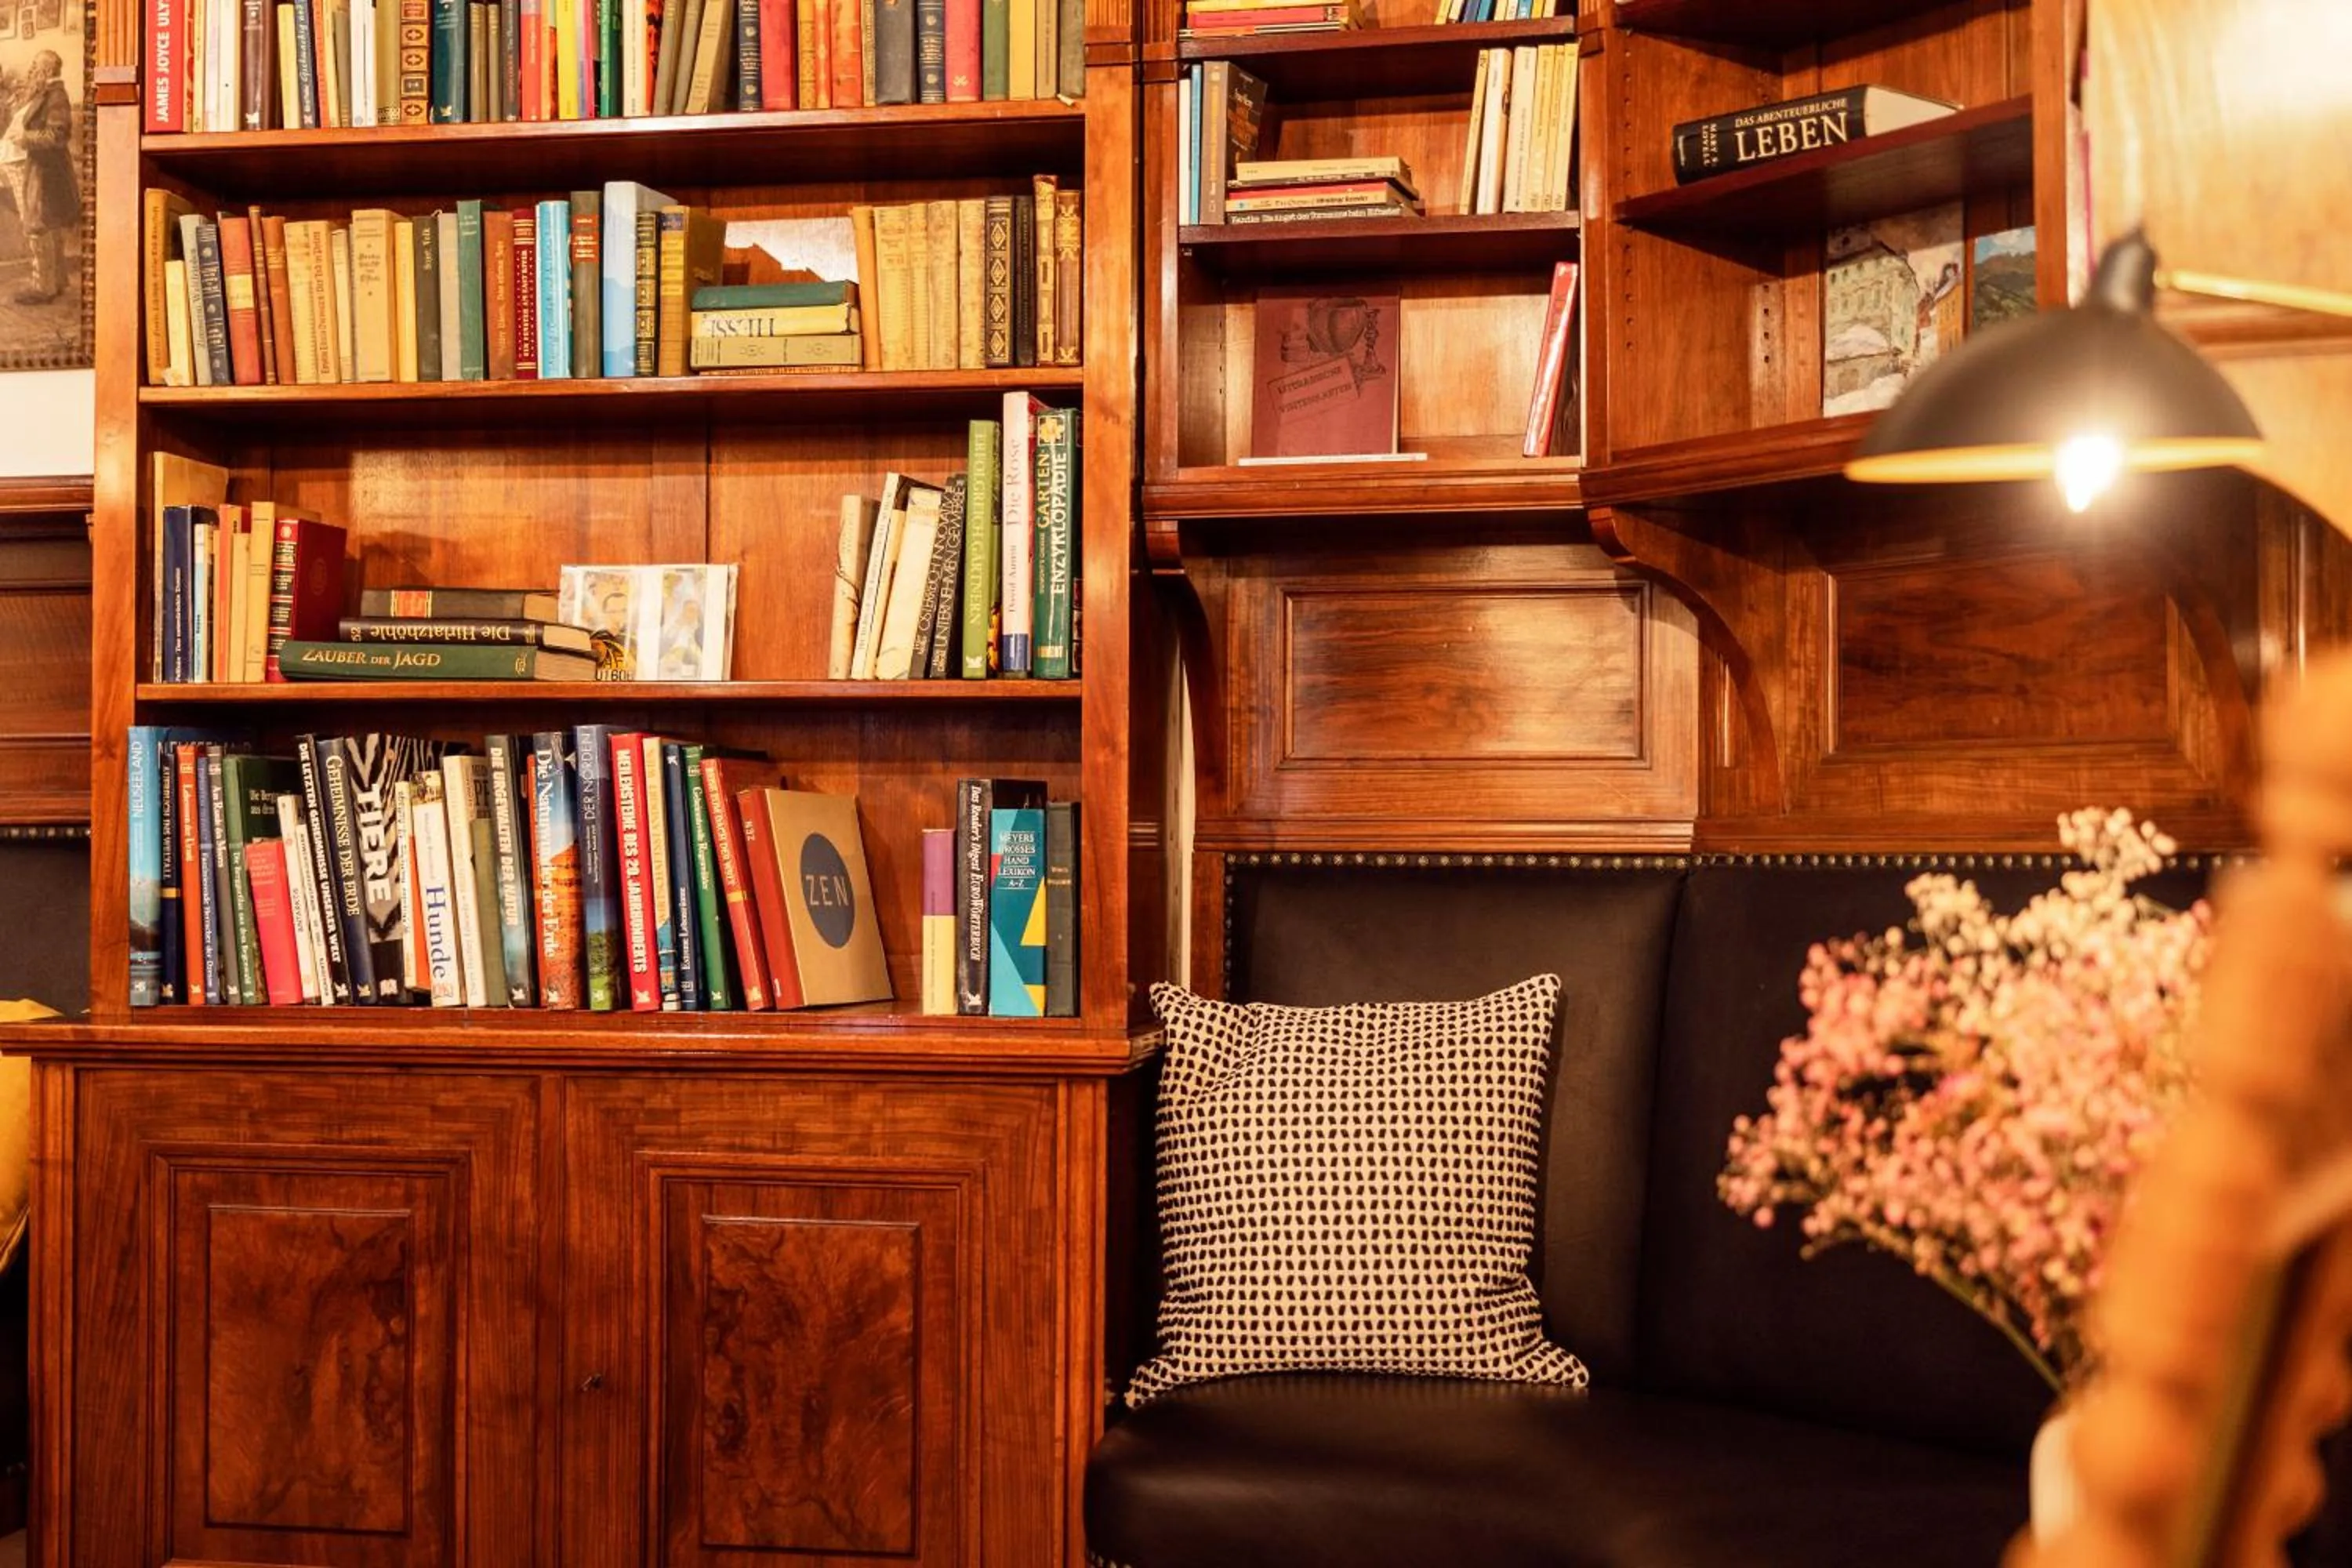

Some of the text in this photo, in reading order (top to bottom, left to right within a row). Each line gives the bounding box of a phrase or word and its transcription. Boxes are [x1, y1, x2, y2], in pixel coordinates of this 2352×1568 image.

[156, 32, 169, 74] JOYCE
[156, 78, 169, 122] JAMES
[1734, 98, 1848, 128] DAS ABENTEUERLICHE
[1710, 122, 1719, 155] MARY
[1734, 113, 1849, 162] LEBEN
[522, 294, 529, 307] AM
[1004, 437, 1022, 526] Die Rose
[1036, 451, 1050, 528] GARTEN-
[946, 486, 966, 548] GEWERBE
[969, 433, 986, 626] ERFOLGREICH GÄRTNERN
[1050, 446, 1068, 596] ENZYKLOPÄDIE
[935, 551, 958, 648] UNTERNEHMEN
[1008, 583, 1017, 613] David
[370, 624, 511, 641] Die Hirlatzhöhle
[301, 649, 441, 667] ZAUBER DER JAGD
[298, 742, 310, 761] DIE
[581, 733, 596, 786] NORDEN
[132, 741, 143, 818] NEUSEELAND
[162, 765, 171, 816] AUFBRUCH
[212, 785, 221, 800] Am
[302, 763, 318, 809] LETZTEN
[971, 786, 982, 803] Das
[584, 787, 595, 820] DER
[971, 804, 982, 842] Reader's
[309, 809, 328, 880] GEHEIMNISSE
[325, 755, 361, 916] GEHEIMNISSE DER ERDE
[358, 784, 390, 903] TIERE
[490, 747, 518, 927] DIE URGEWALTEN DER NATUR
[536, 750, 561, 957] Die Naturwunder der Erde
[967, 843, 982, 871] Digest
[998, 844, 1036, 854] GROSSES
[999, 833, 1035, 843] MEYERS
[162, 837, 171, 880] WELTALL
[616, 749, 648, 974] MEILENSTEINE DES 20. JAHRHUNDERTS
[997, 867, 1036, 876] LEXIKON
[1003, 856, 1029, 865] HAND
[320, 882, 336, 934] UNSERER
[804, 874, 850, 906] ZEN
[328, 934, 342, 963] WELT
[426, 886, 451, 979] Hunde
